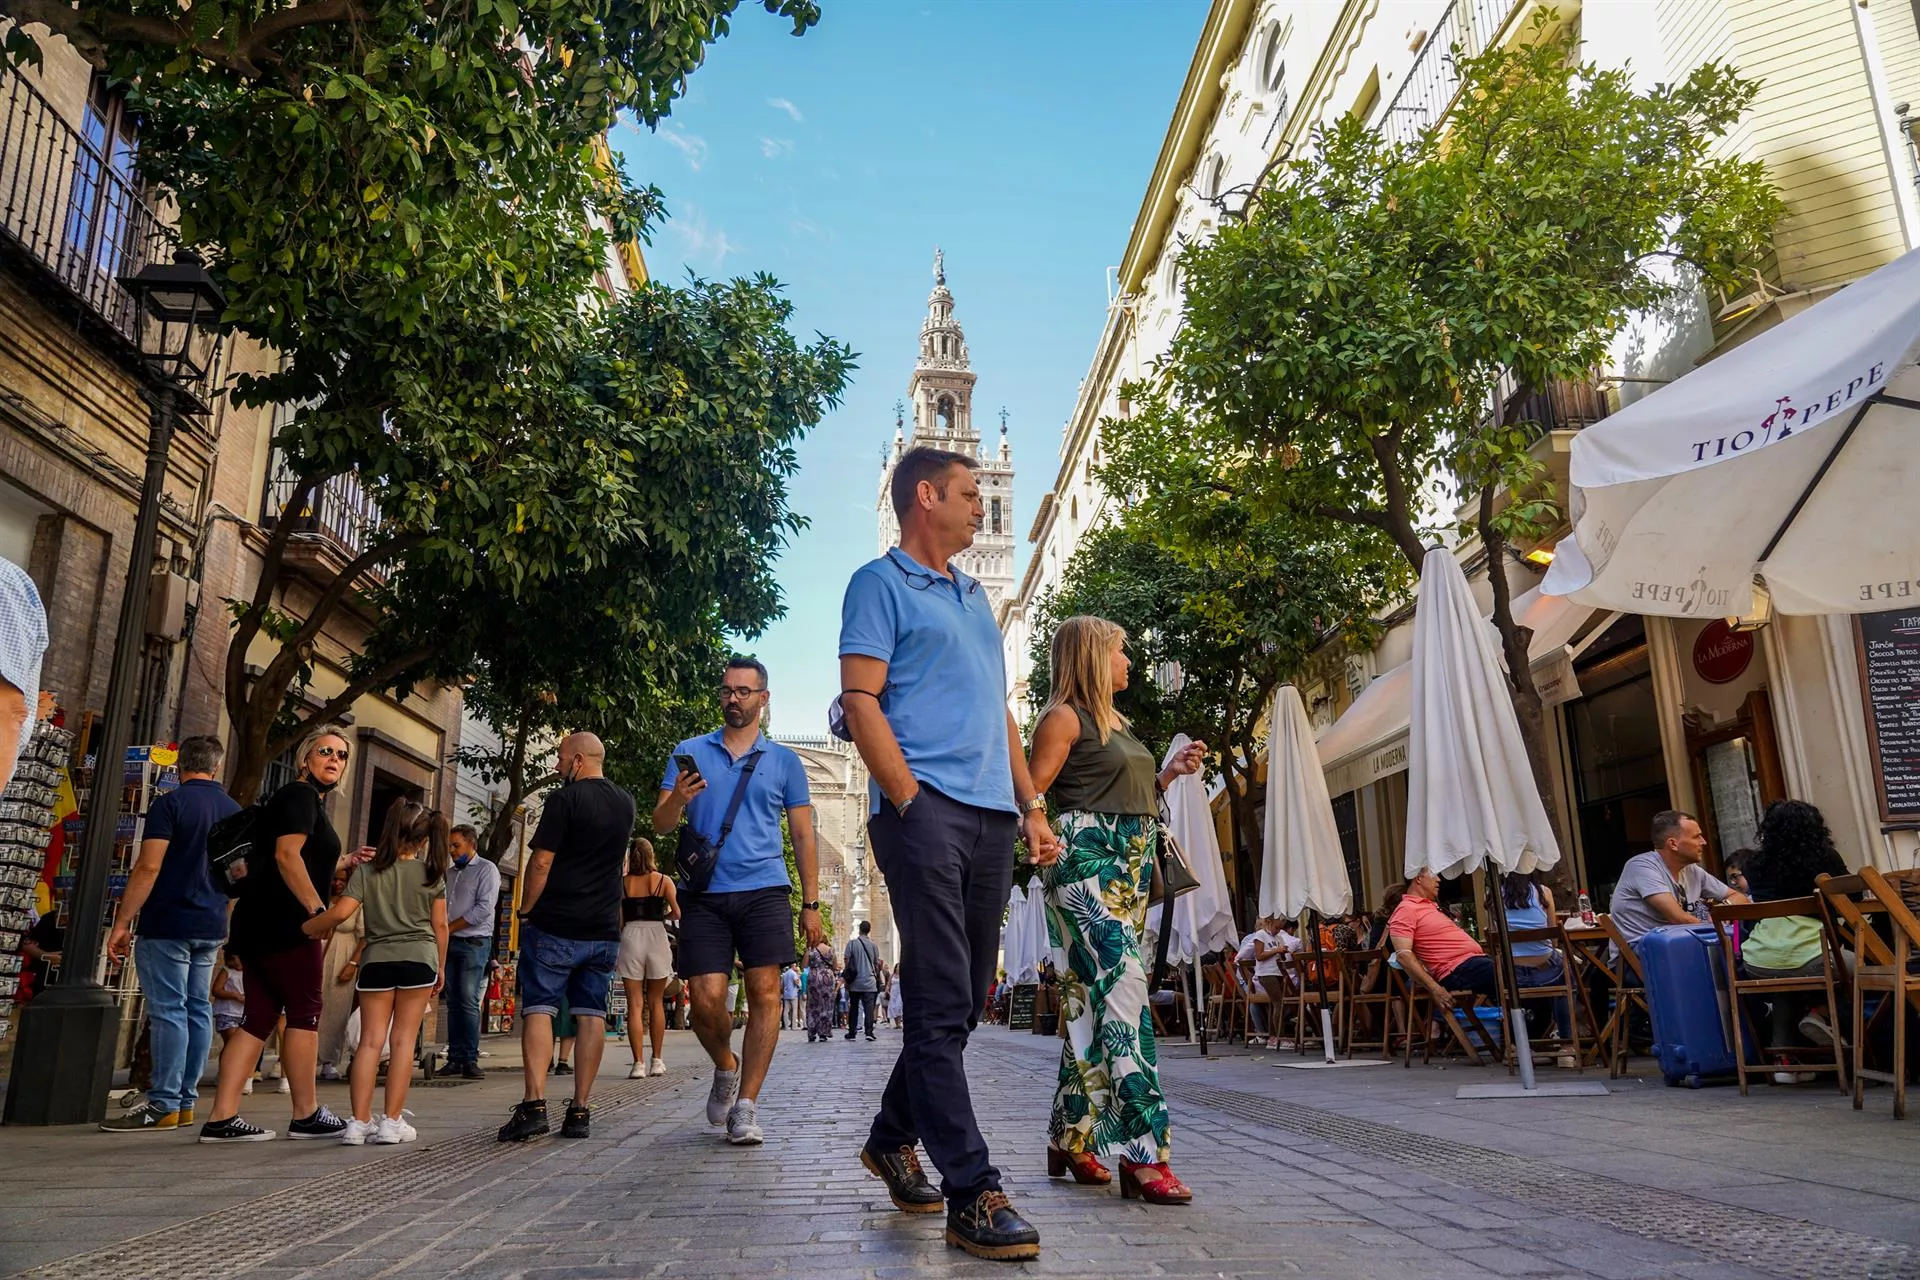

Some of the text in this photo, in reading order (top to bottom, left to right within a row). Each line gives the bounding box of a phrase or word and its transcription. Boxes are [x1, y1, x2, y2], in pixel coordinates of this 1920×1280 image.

[1691, 361, 1884, 463] TIO PEPE
[1380, 745, 1407, 770] MODERNA
